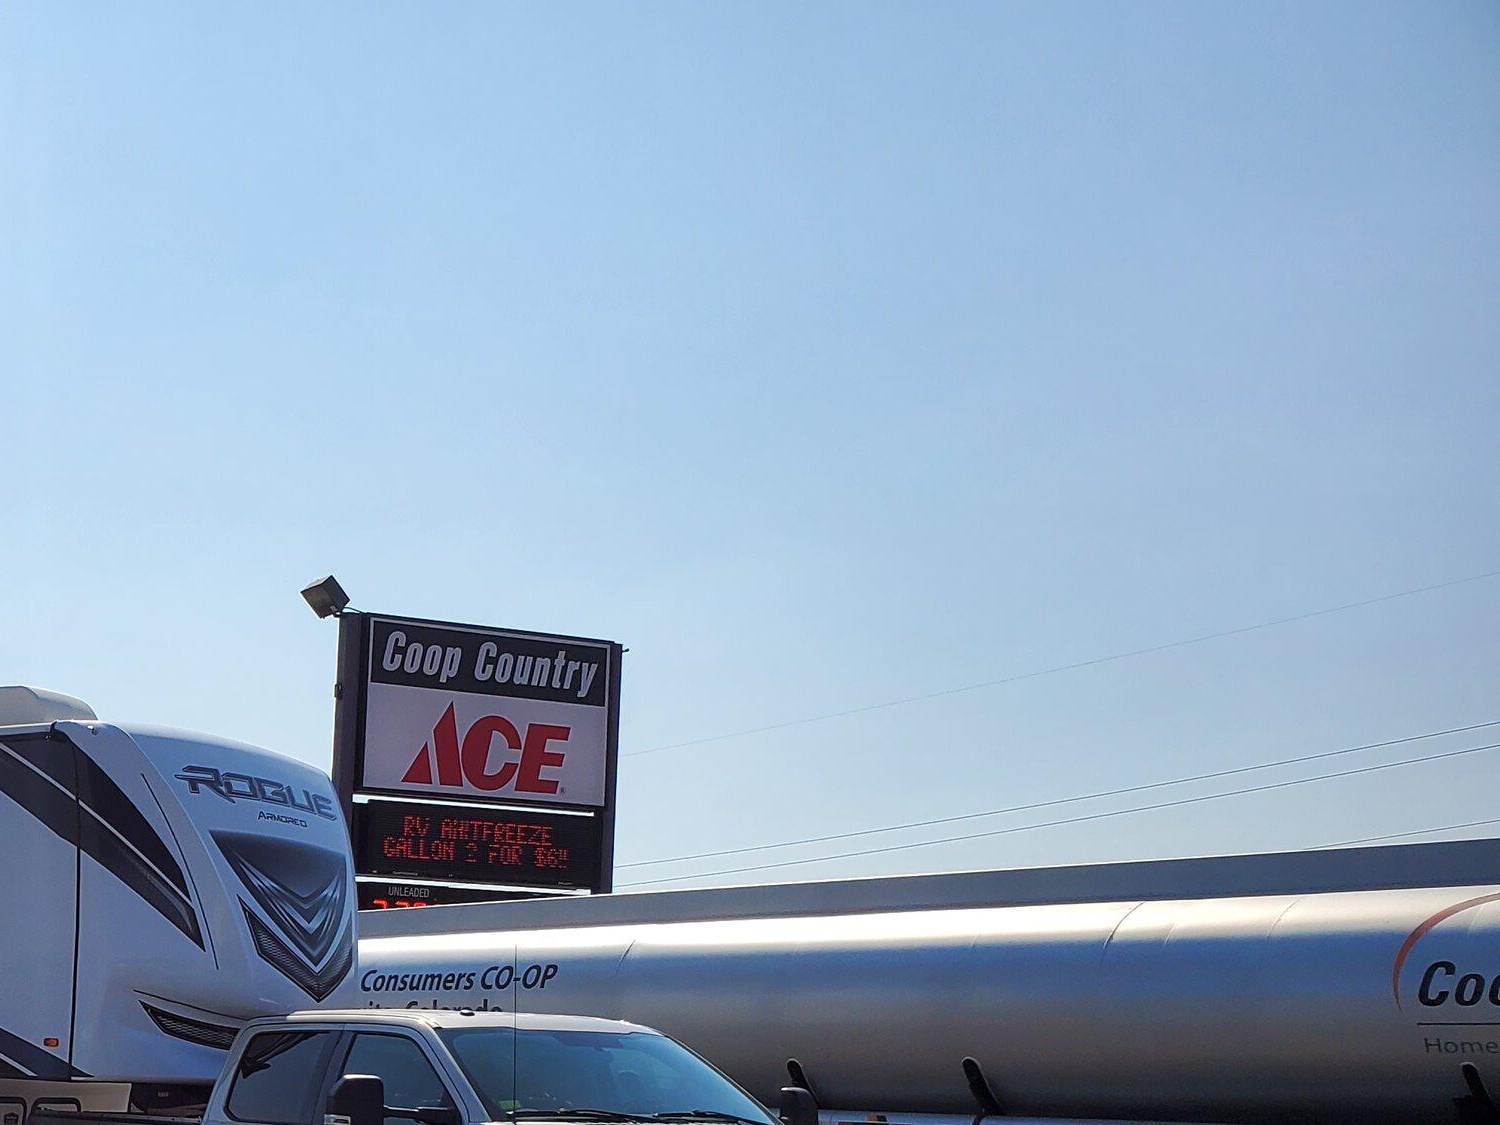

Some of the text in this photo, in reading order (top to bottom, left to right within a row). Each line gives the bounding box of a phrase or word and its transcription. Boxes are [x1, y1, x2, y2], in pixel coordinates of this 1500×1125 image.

[382, 631, 598, 697] Coop Country
[401, 700, 571, 795] ACE
[174, 765, 337, 821] ROGUE
[257, 810, 308, 828] ARMORED
[403, 816, 430, 837] RV
[383, 835, 455, 861] GALLON
[489, 844, 523, 866] FOR
[388, 886, 430, 898] UNLEADED
[360, 964, 559, 992] Consumers CO-OP
